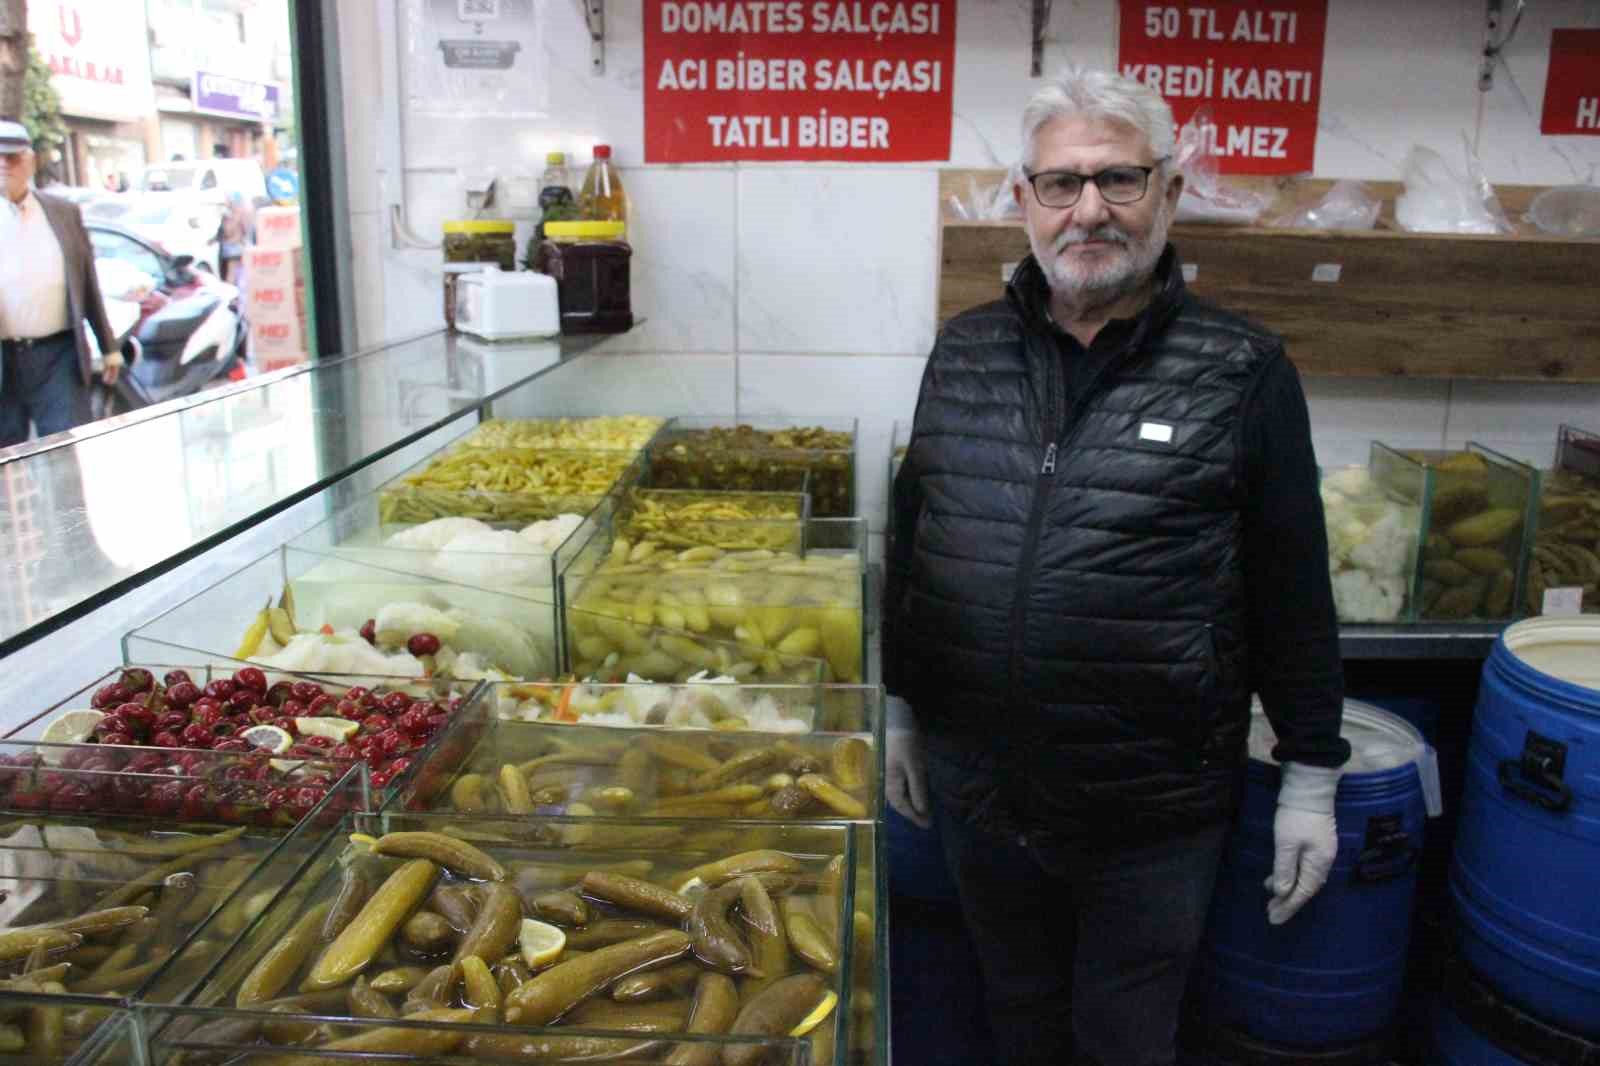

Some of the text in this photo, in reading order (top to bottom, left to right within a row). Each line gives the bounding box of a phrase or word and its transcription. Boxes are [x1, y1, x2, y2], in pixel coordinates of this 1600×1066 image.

[661, 1, 940, 41] DOMATES SALÇASI
[1145, 7, 1297, 43] 50 TL ALTI
[657, 51, 941, 100] ACI BİBER SALÇASI
[1221, 67, 1312, 102] KARTI
[707, 107, 890, 148] TATLI BİBER
